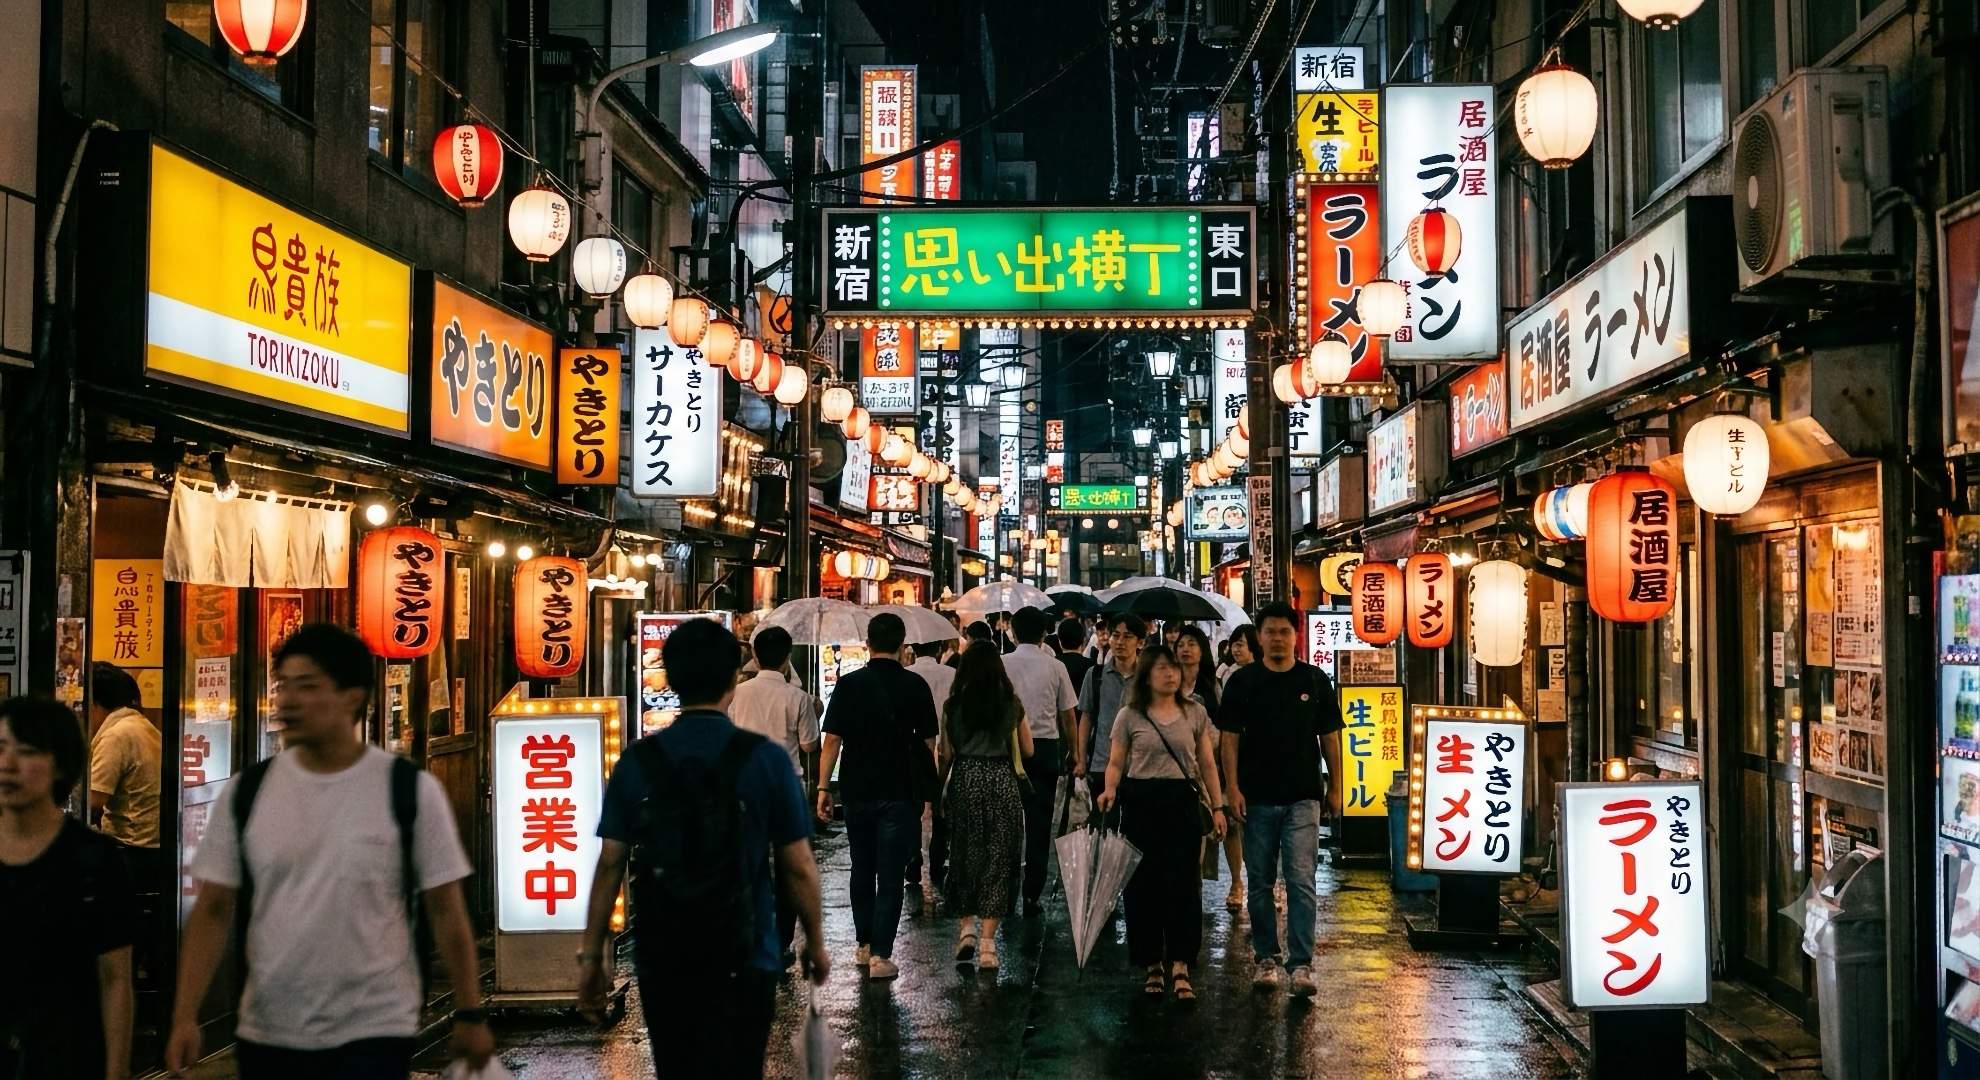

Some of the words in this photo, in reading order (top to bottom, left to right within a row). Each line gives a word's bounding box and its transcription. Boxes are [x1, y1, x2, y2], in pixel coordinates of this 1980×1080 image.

[1301, 53, 1356, 79] 新宿
[1458, 100, 1488, 197] 居酒屋
[834, 224, 871, 301] 新宿
[900, 227, 1182, 296] 思い出横丁
[1207, 223, 1245, 298] 東口
[1416, 153, 1462, 341] ラン
[248, 332, 340, 389] TORIKIZOKU
[441, 318, 546, 437] やきとり
[1520, 308, 1571, 410] 居酒屋
[1584, 247, 1675, 382] ラーメン
[571, 354, 609, 479] やきとり
[645, 346, 674, 486] サーカケス
[685, 348, 704, 434] やきとり
[393, 541, 435, 648] やきとり
[1628, 489, 1671, 603] 居酒屋
[540, 567, 575, 667] やきとり
[1419, 562, 1444, 639] ラーメン
[1346, 698, 1376, 808] 生ビール
[1484, 732, 1515, 863] やきとり
[521, 734, 578, 916] 営業中
[1666, 795, 1692, 895] やきとり
[1598, 799, 1662, 997] ラーメン
